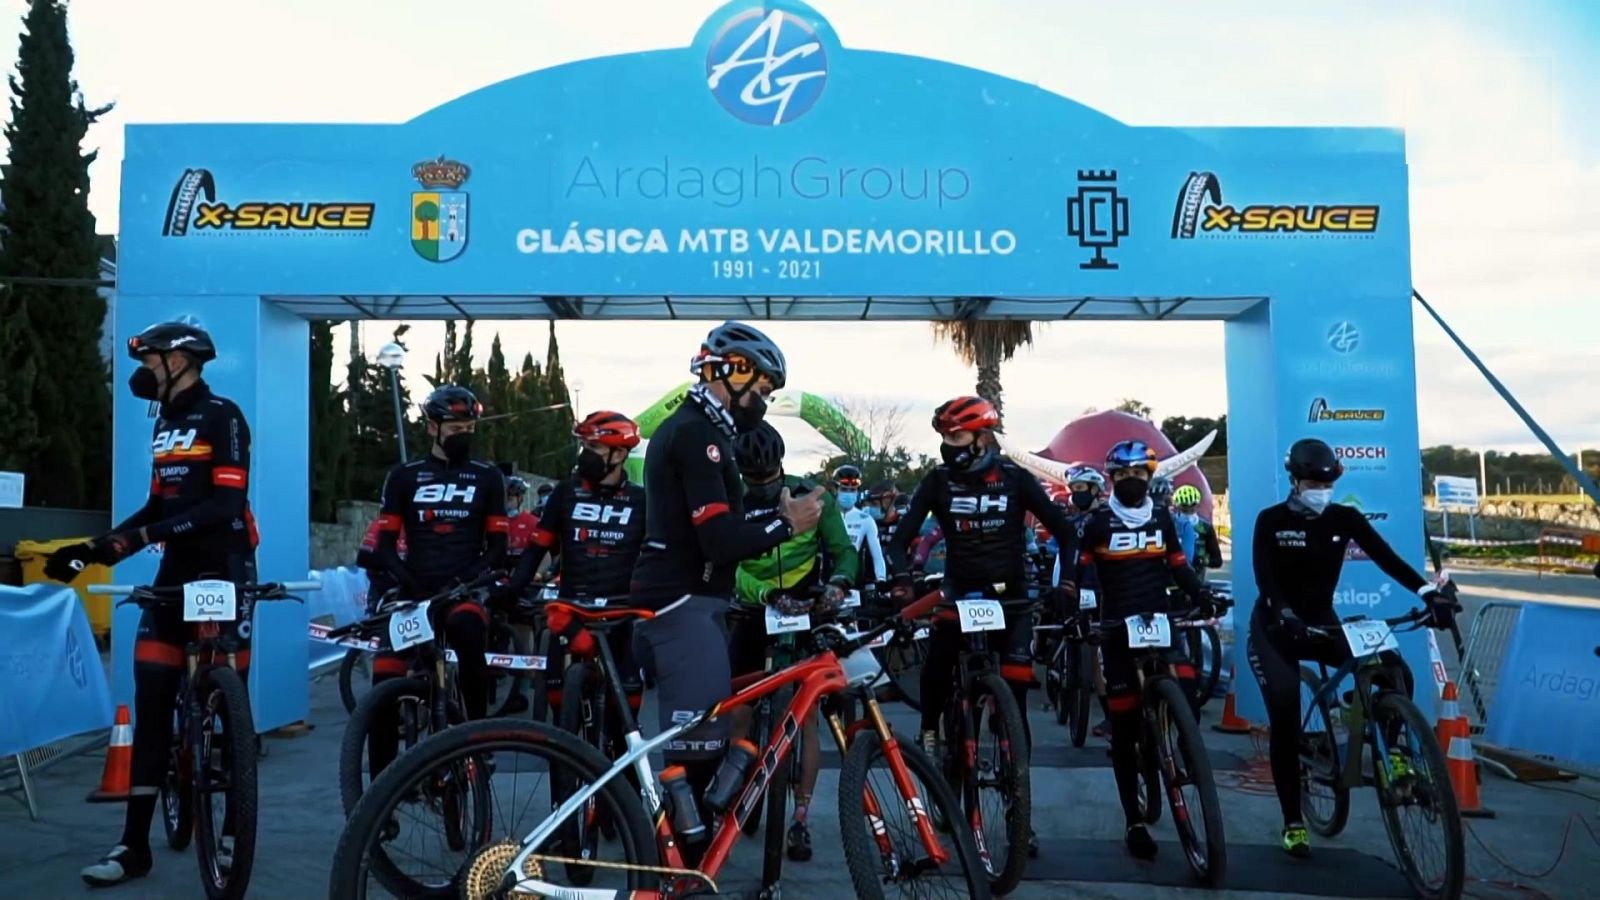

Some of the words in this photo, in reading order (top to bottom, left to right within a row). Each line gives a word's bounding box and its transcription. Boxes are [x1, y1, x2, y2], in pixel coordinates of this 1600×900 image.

[708, 9, 826, 126] AG
[565, 154, 972, 209] ArdaghGroup
[195, 204, 373, 228] X-SAUCE
[1203, 206, 1378, 231] X-SAUCE
[516, 222, 668, 253] CLÁSICA
[678, 229, 749, 253] MTB
[758, 229, 1017, 255] VALDEMORILLO
[713, 260, 755, 278] 1991
[779, 260, 821, 279] 2021
[1334, 447, 1386, 459] BOSCH
[413, 484, 476, 503] BH
[571, 502, 632, 525] BH
[950, 495, 1009, 514] BH
[1109, 530, 1163, 551] BH
[195, 593, 225, 606] 004
[1333, 587, 1382, 608] stlap
[968, 607, 994, 618] 006
[396, 620, 420, 635] 005
[1136, 624, 1160, 636] 001
[1359, 631, 1383, 643] 151
